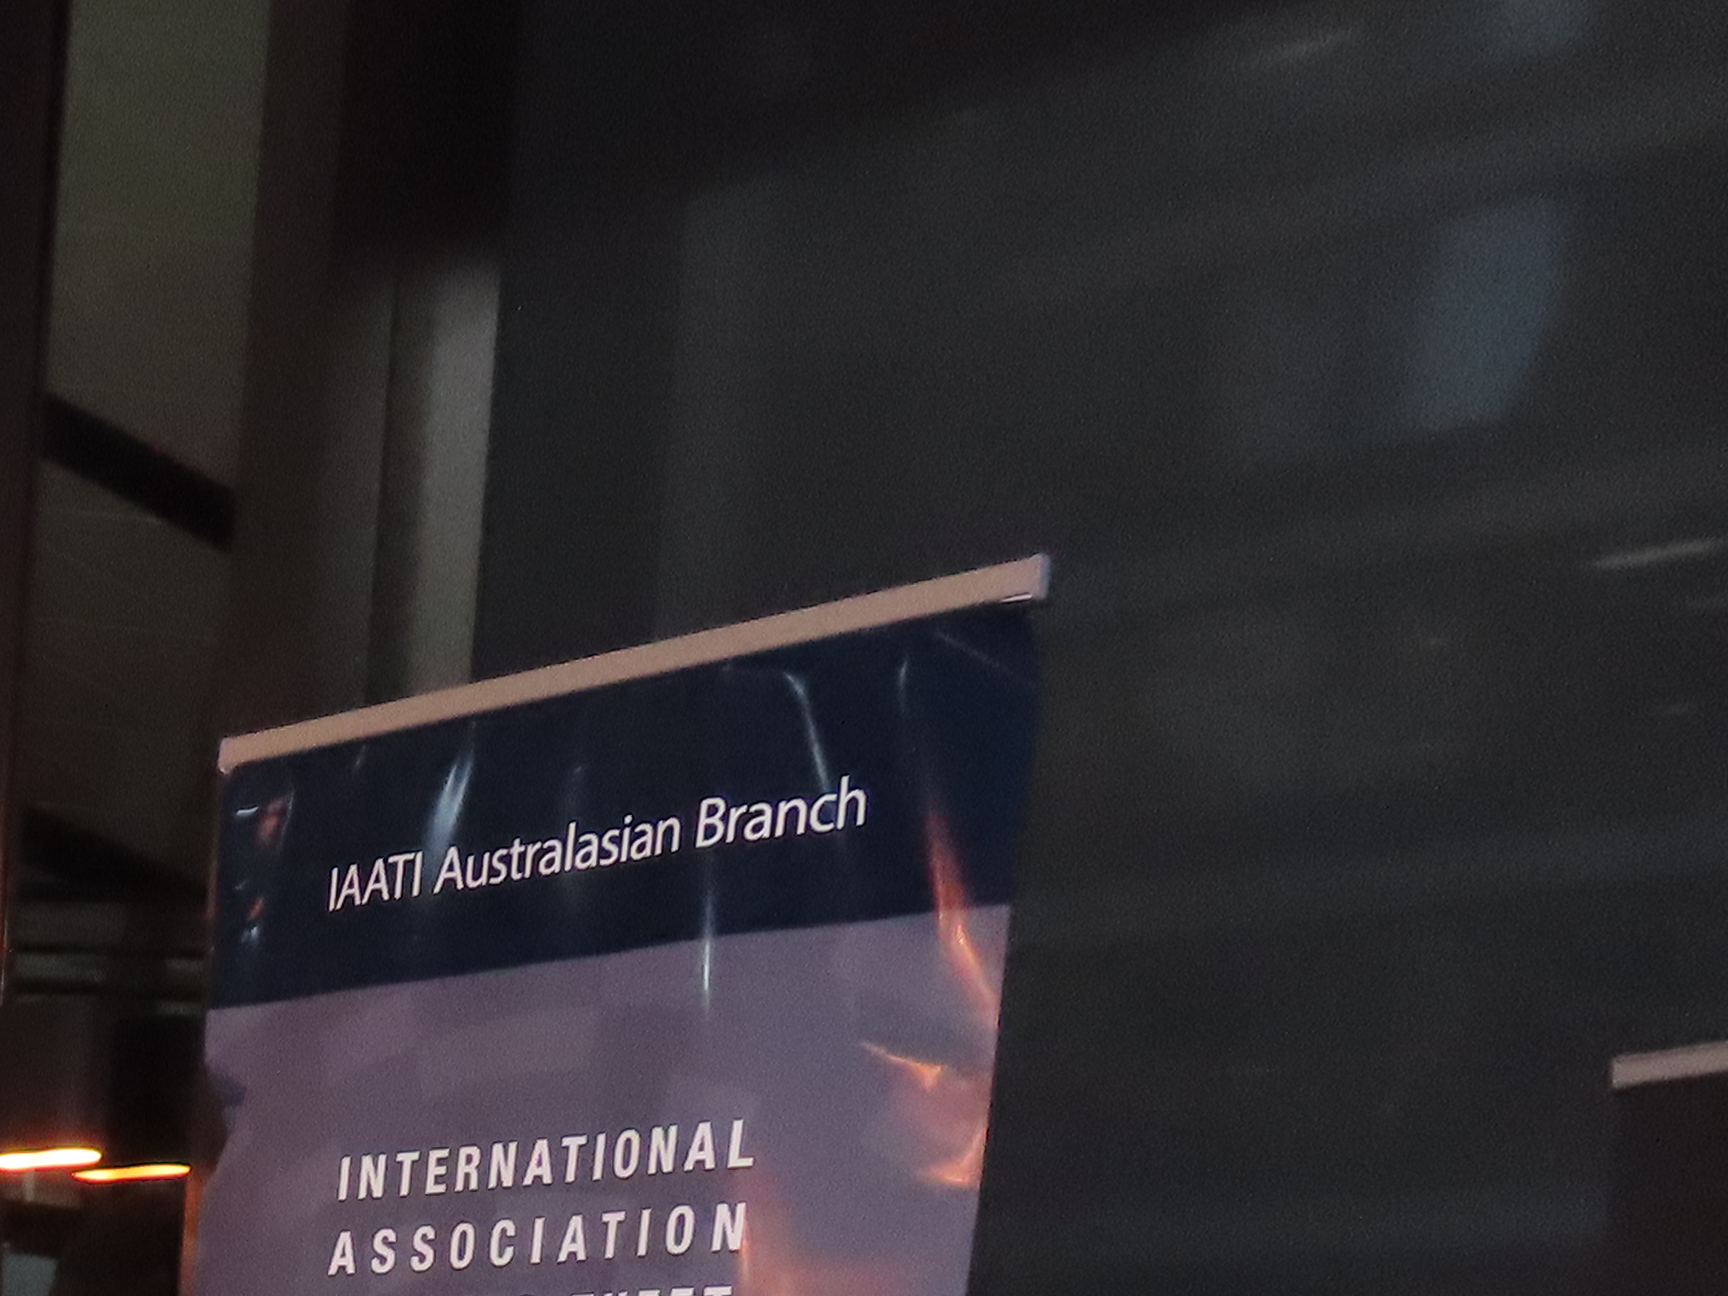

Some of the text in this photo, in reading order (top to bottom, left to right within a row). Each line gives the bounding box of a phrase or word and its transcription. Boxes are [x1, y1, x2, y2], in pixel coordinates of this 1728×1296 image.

[328, 775, 868, 912] IAATI Australasian Branch
[337, 1119, 756, 1201] INTERNATIONAL
[328, 1203, 748, 1276] ASSOCIATION
